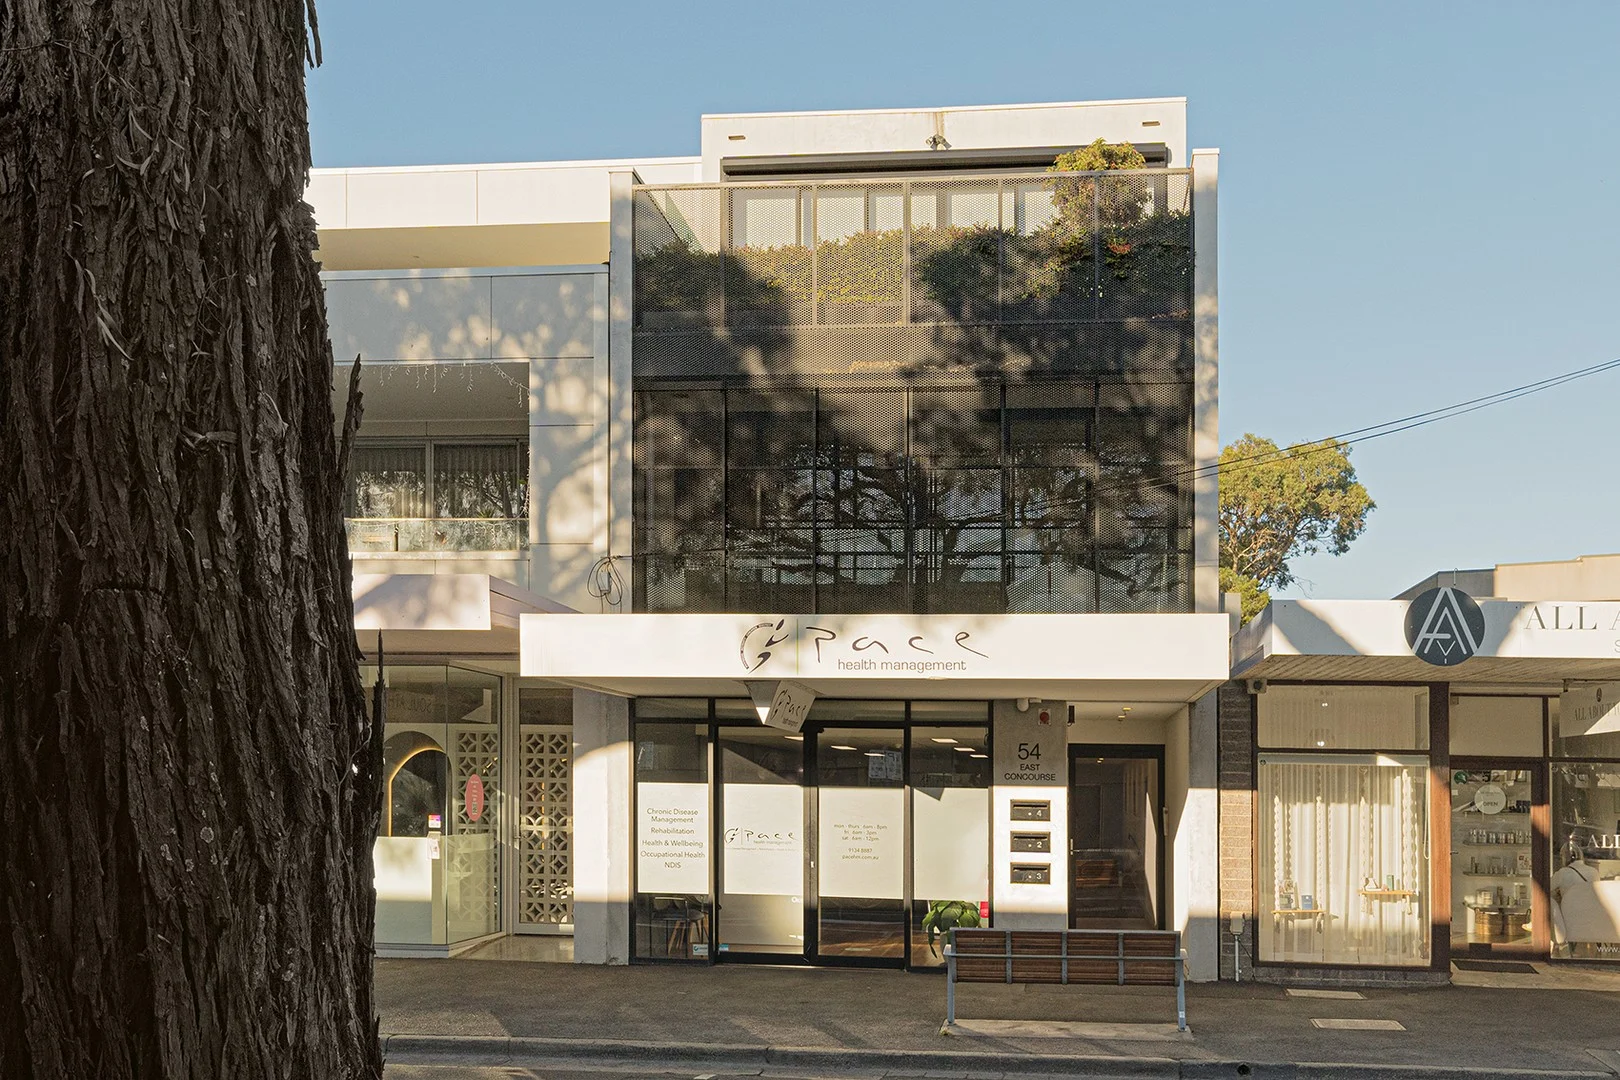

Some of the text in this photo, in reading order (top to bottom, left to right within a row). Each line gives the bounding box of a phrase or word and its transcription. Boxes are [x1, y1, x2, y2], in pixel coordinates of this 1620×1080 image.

[1524, 606, 1598, 630] ALL
[805, 626, 989, 664] Pace
[838, 659, 966, 674] health management
[1018, 743, 1041, 760] 54
[1004, 773, 1056, 781] CONCOURSE
[651, 816, 694, 824] Management
[670, 840, 704, 848] Wellbeing
[640, 850, 683, 858] Occupational
